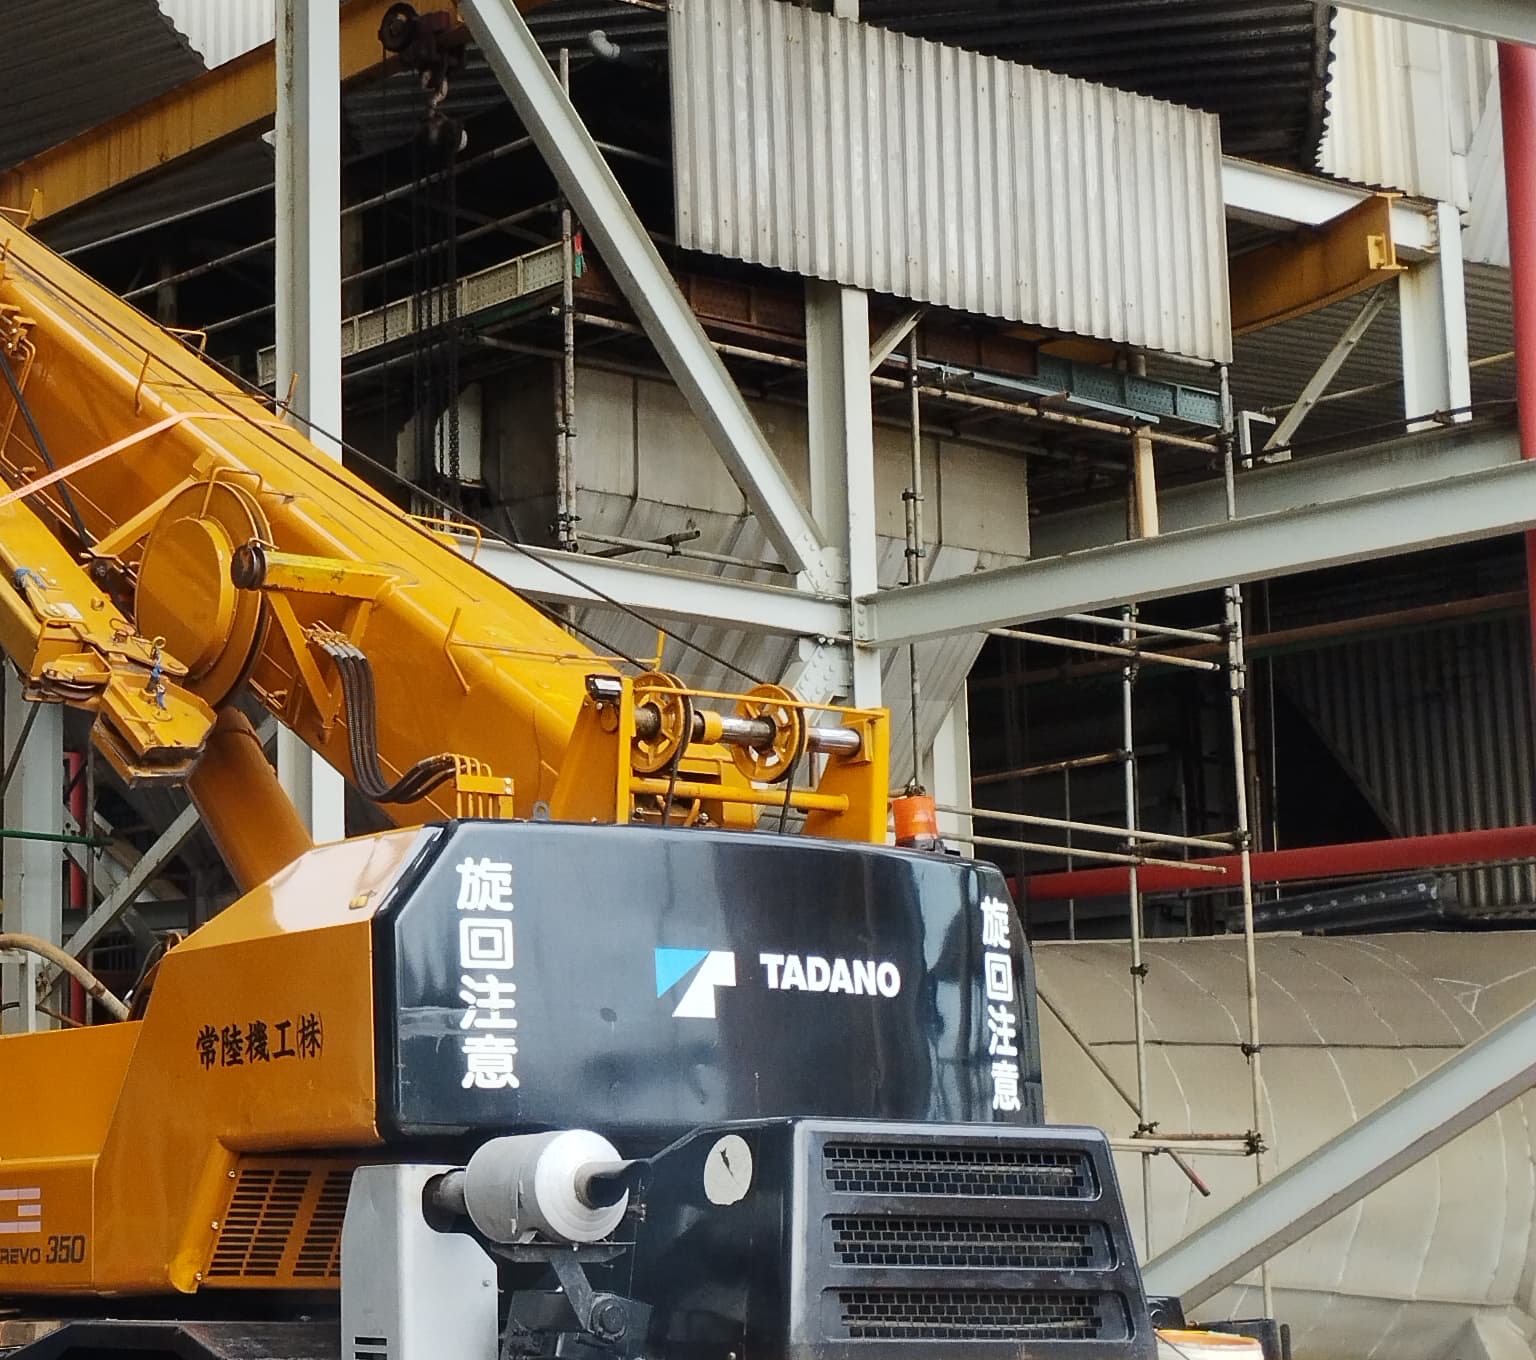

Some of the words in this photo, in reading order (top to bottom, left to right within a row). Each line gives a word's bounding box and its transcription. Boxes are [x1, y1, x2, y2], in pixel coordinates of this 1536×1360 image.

[455, 857, 519, 1089] 旋回注意
[760, 953, 901, 999] TADANO
[979, 896, 1021, 1111] 旋回注意
[46, 1235, 86, 1264] 350
